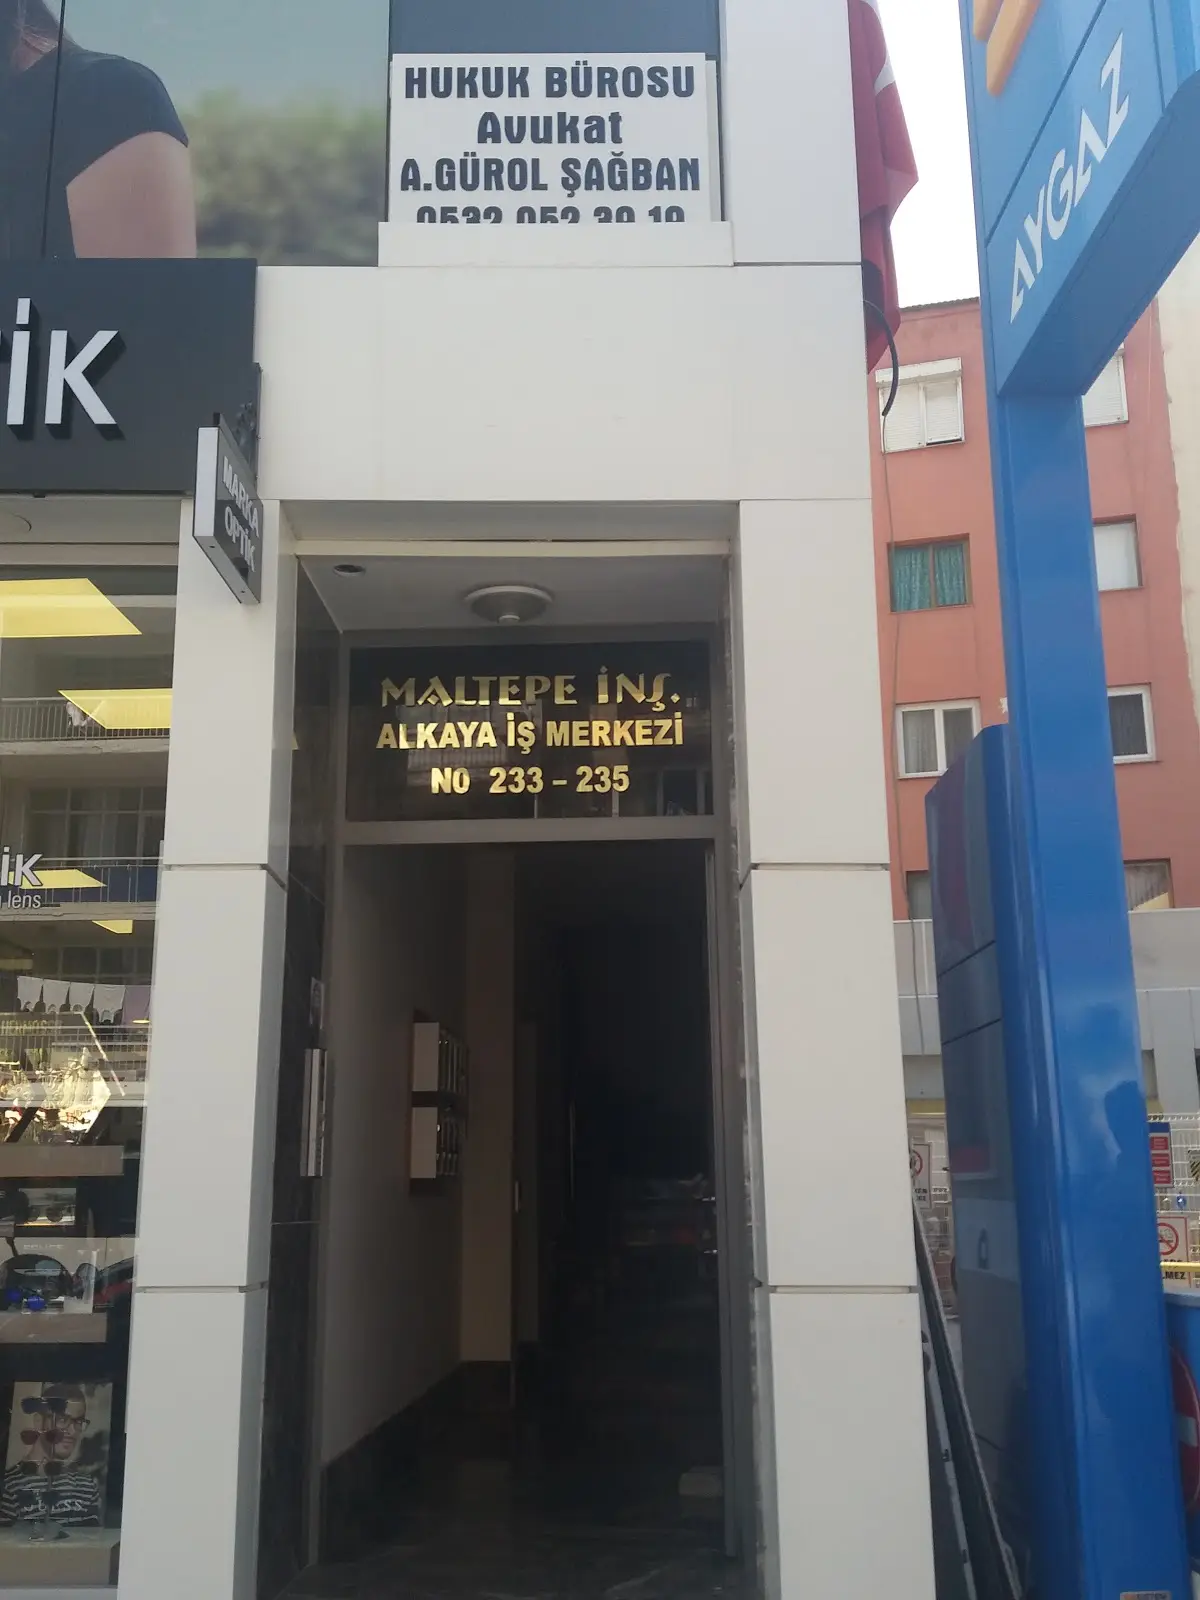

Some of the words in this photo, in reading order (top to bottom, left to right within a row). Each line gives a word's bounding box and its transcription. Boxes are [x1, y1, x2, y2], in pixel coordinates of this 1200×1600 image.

[405, 66, 530, 99] HUKUK
[545, 60, 695, 98] BÜROSU
[477, 111, 623, 144] Avukat
[400, 151, 548, 192] A.GÜROL
[560, 151, 700, 198] ŞAĞBAN
[1009, 28, 1130, 324] AYGAZ
[0, 298, 119, 425] İK
[222, 456, 259, 538] MARKA
[224, 506, 255, 573] OPTİK
[381, 675, 578, 707] MALTEPE
[597, 666, 682, 712] İNŞ.
[376, 721, 498, 749] ALKAYA
[506, 712, 536, 754] İŞ
[546, 711, 684, 747] MERKEZİ
[430, 767, 471, 794] NO
[489, 766, 544, 794] 233
[575, 764, 630, 793] 235
[8, 890, 42, 909] lens
[1162, 1271, 1187, 1280] MEZ
